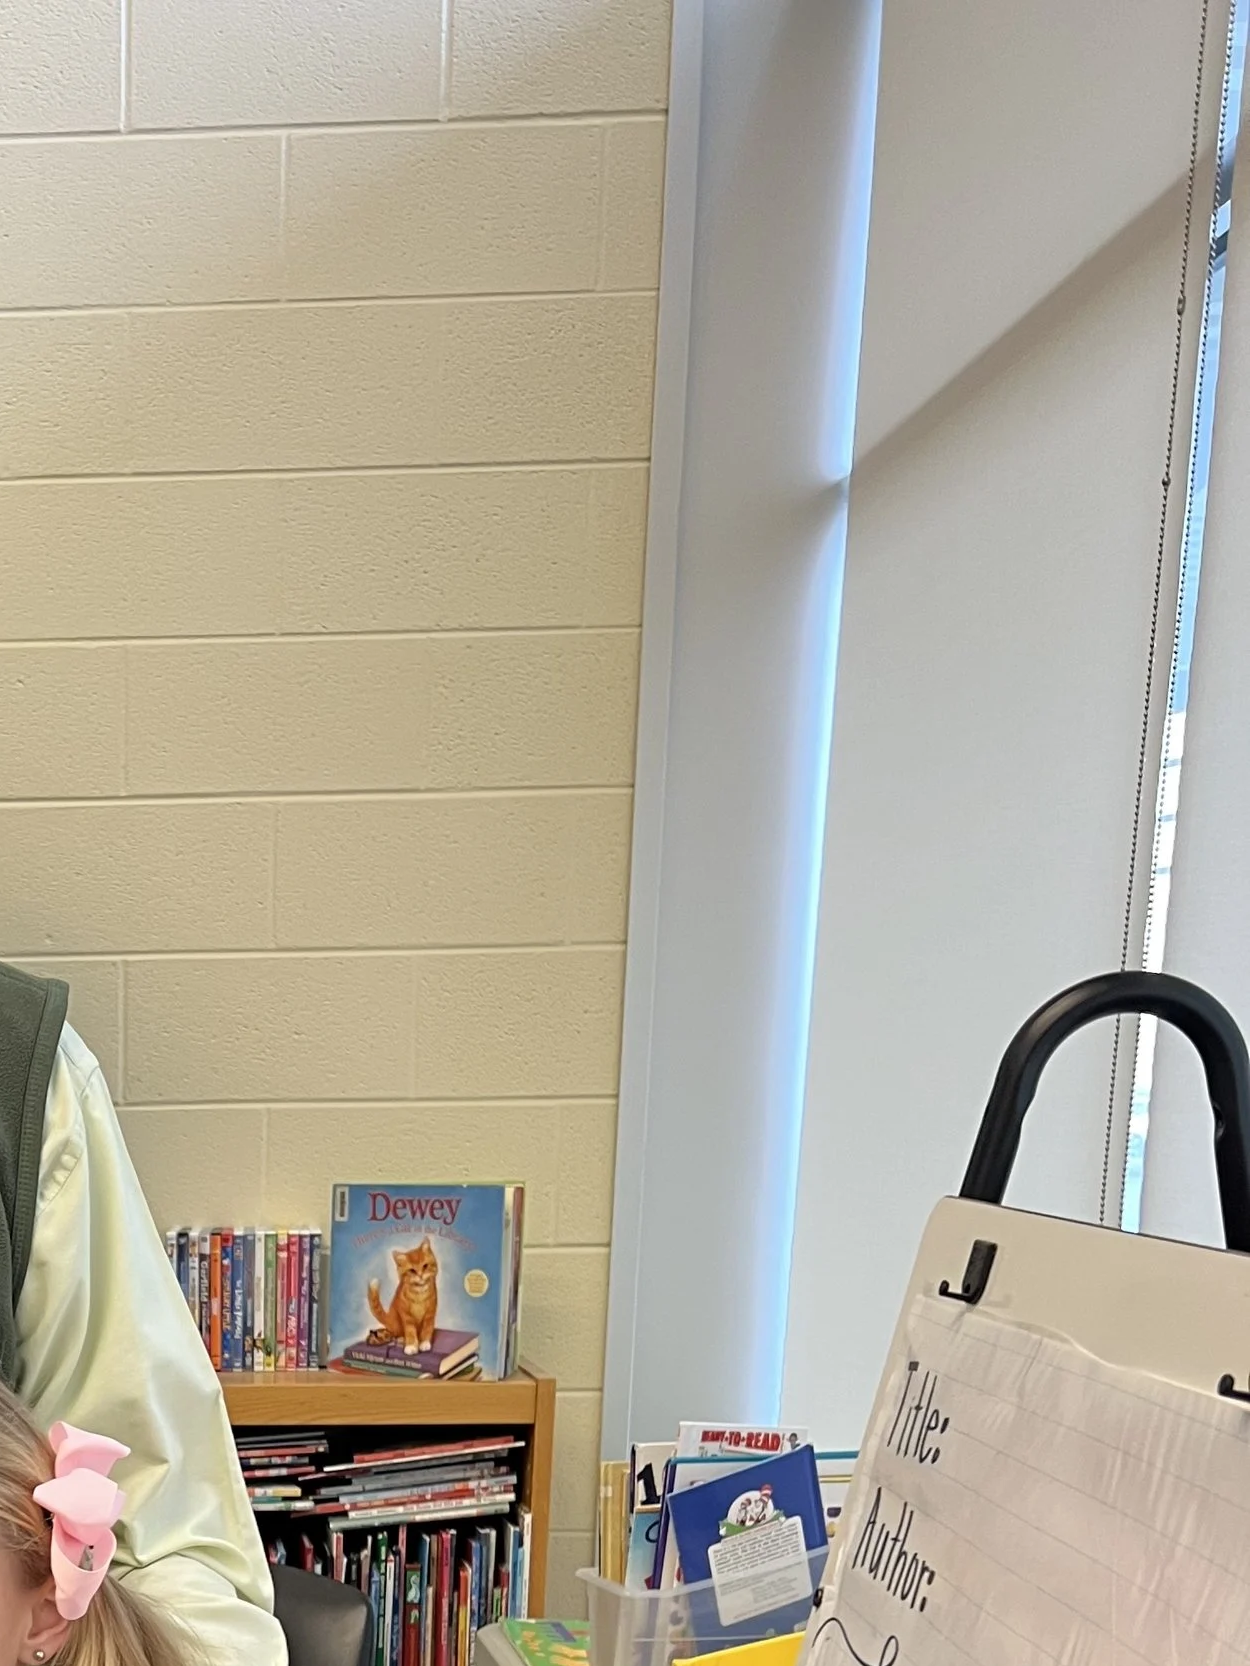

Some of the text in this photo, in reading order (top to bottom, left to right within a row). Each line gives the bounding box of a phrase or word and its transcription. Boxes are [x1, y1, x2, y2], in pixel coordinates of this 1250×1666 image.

[367, 1191, 462, 1226] Dewey
[888, 1360, 950, 1465] Title:
[852, 1487, 935, 1612] Author:
